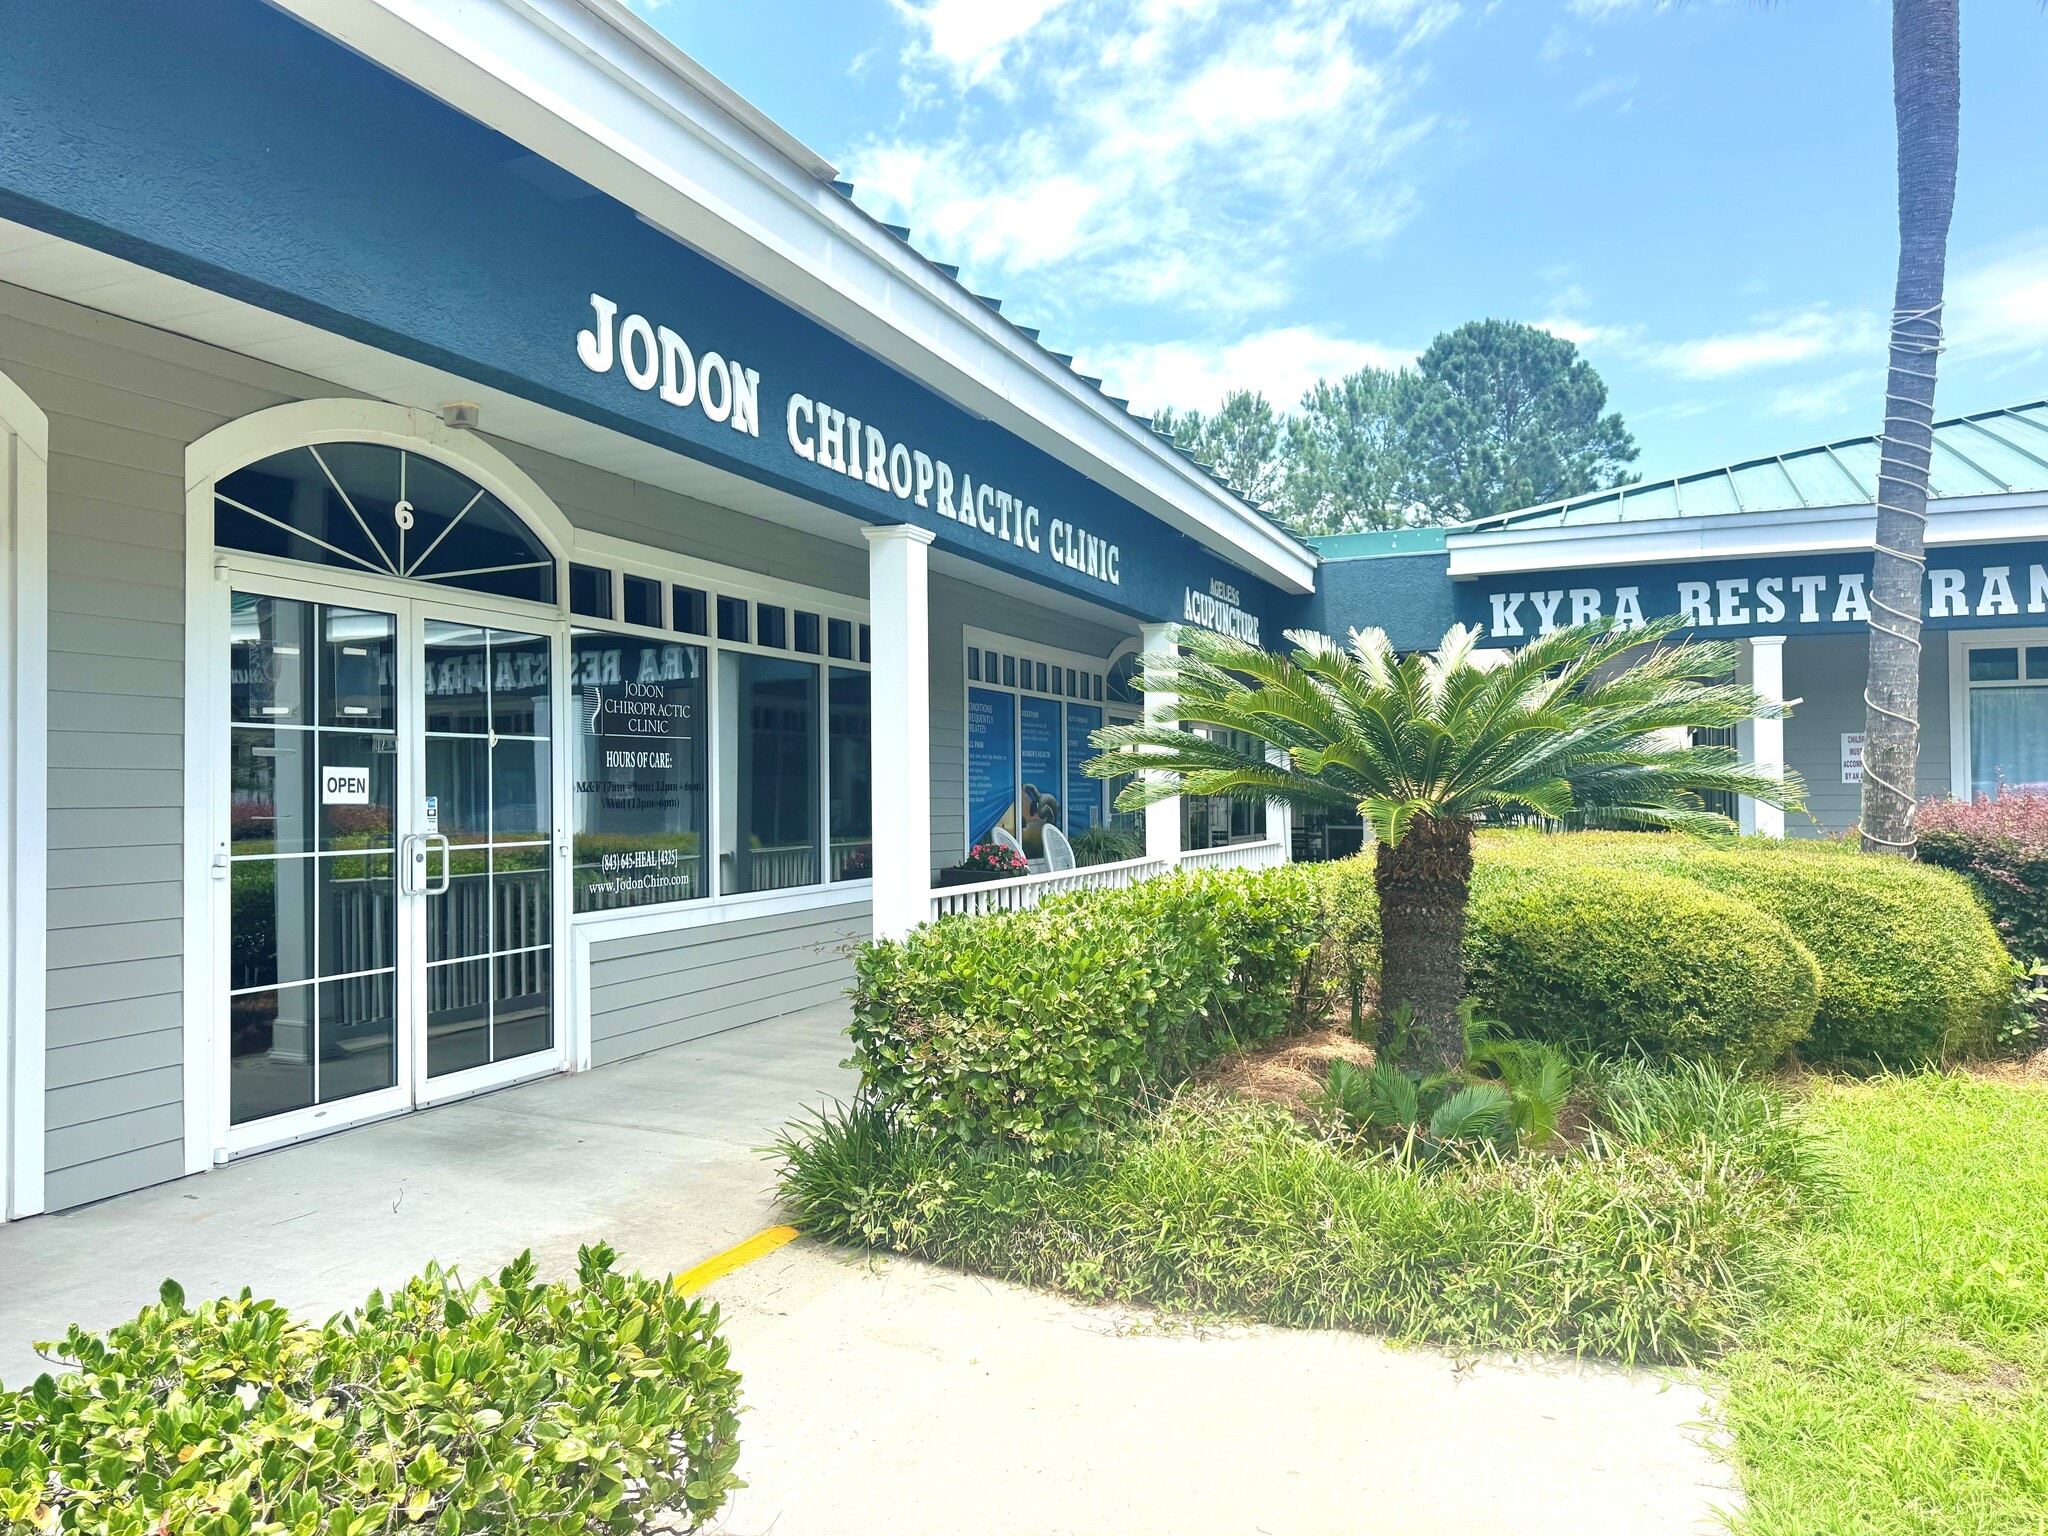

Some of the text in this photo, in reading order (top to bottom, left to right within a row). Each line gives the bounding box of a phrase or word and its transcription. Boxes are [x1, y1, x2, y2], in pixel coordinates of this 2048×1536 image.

[576, 293, 1120, 586] JODON CHIROPRACTIC CLINIC
[395, 500, 414, 530] 6
[1210, 577, 1240, 606] AGELESS
[1490, 564, 2048, 637] KYRA RESTARAN
[1184, 586, 1260, 646] ACUPUNCTURE
[624, 680, 664, 698] JODON
[604, 698, 691, 718] CHIROPRACTIC
[969, 702, 993, 713] ONDITIONS
[628, 718, 669, 733] CLINIC
[969, 713, 993, 724] REQUENTLY
[969, 724, 987, 734] REATED:
[606, 751, 673, 768] HOURS OF CARE:
[327, 777, 366, 793] OPEN
[601, 848, 678, 874] (843) 645-HEAL [4325]
[589, 874, 690, 894] www.JodonChiro.com
